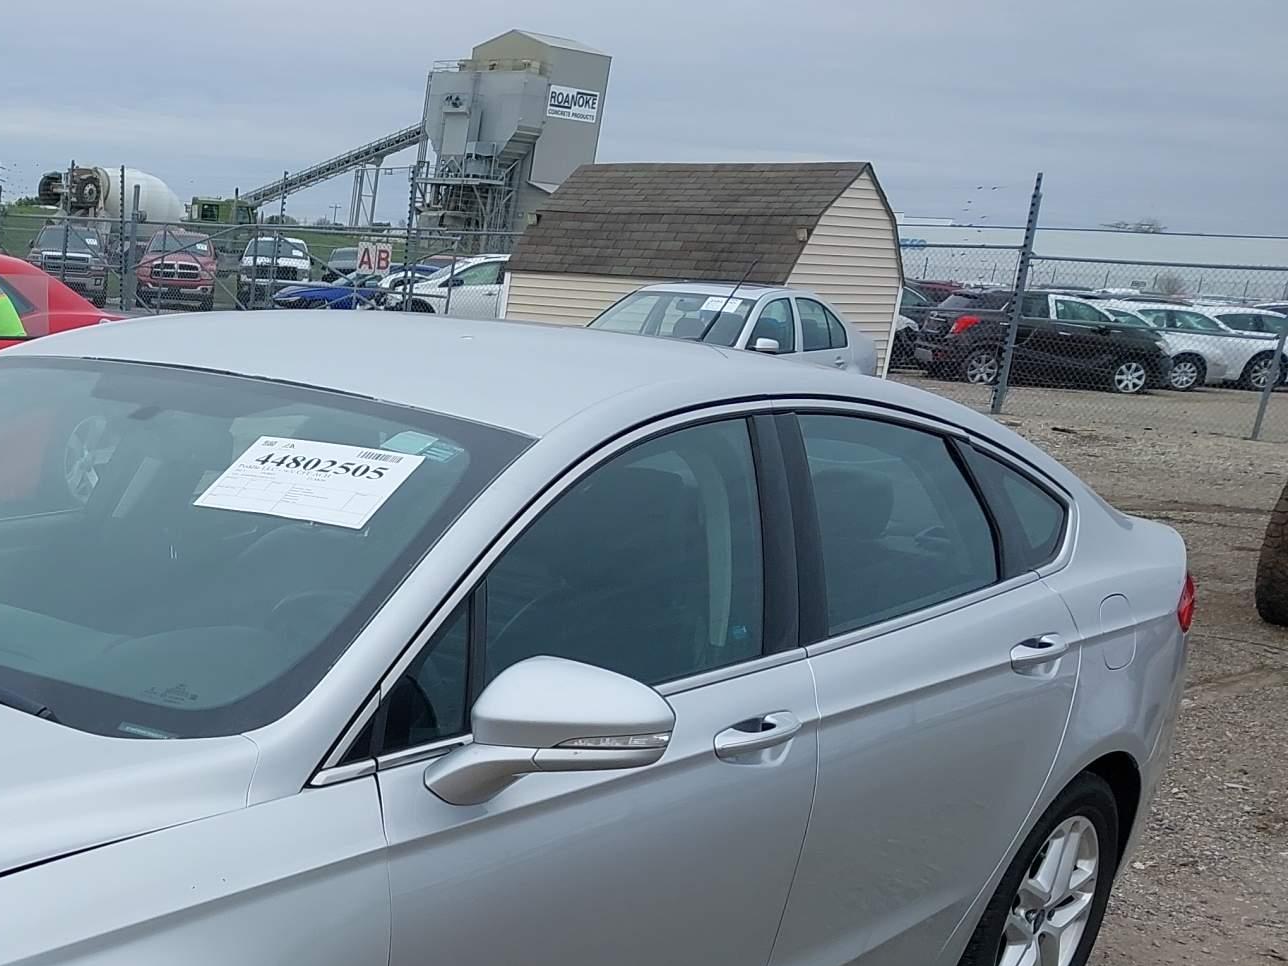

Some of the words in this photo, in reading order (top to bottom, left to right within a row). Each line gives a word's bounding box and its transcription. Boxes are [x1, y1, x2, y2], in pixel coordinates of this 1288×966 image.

[549, 91, 598, 110] ROANOKE
[548, 108, 570, 118] CONCRETE
[571, 111, 595, 121] PRODUCTS
[255, 452, 389, 480] 44802505
